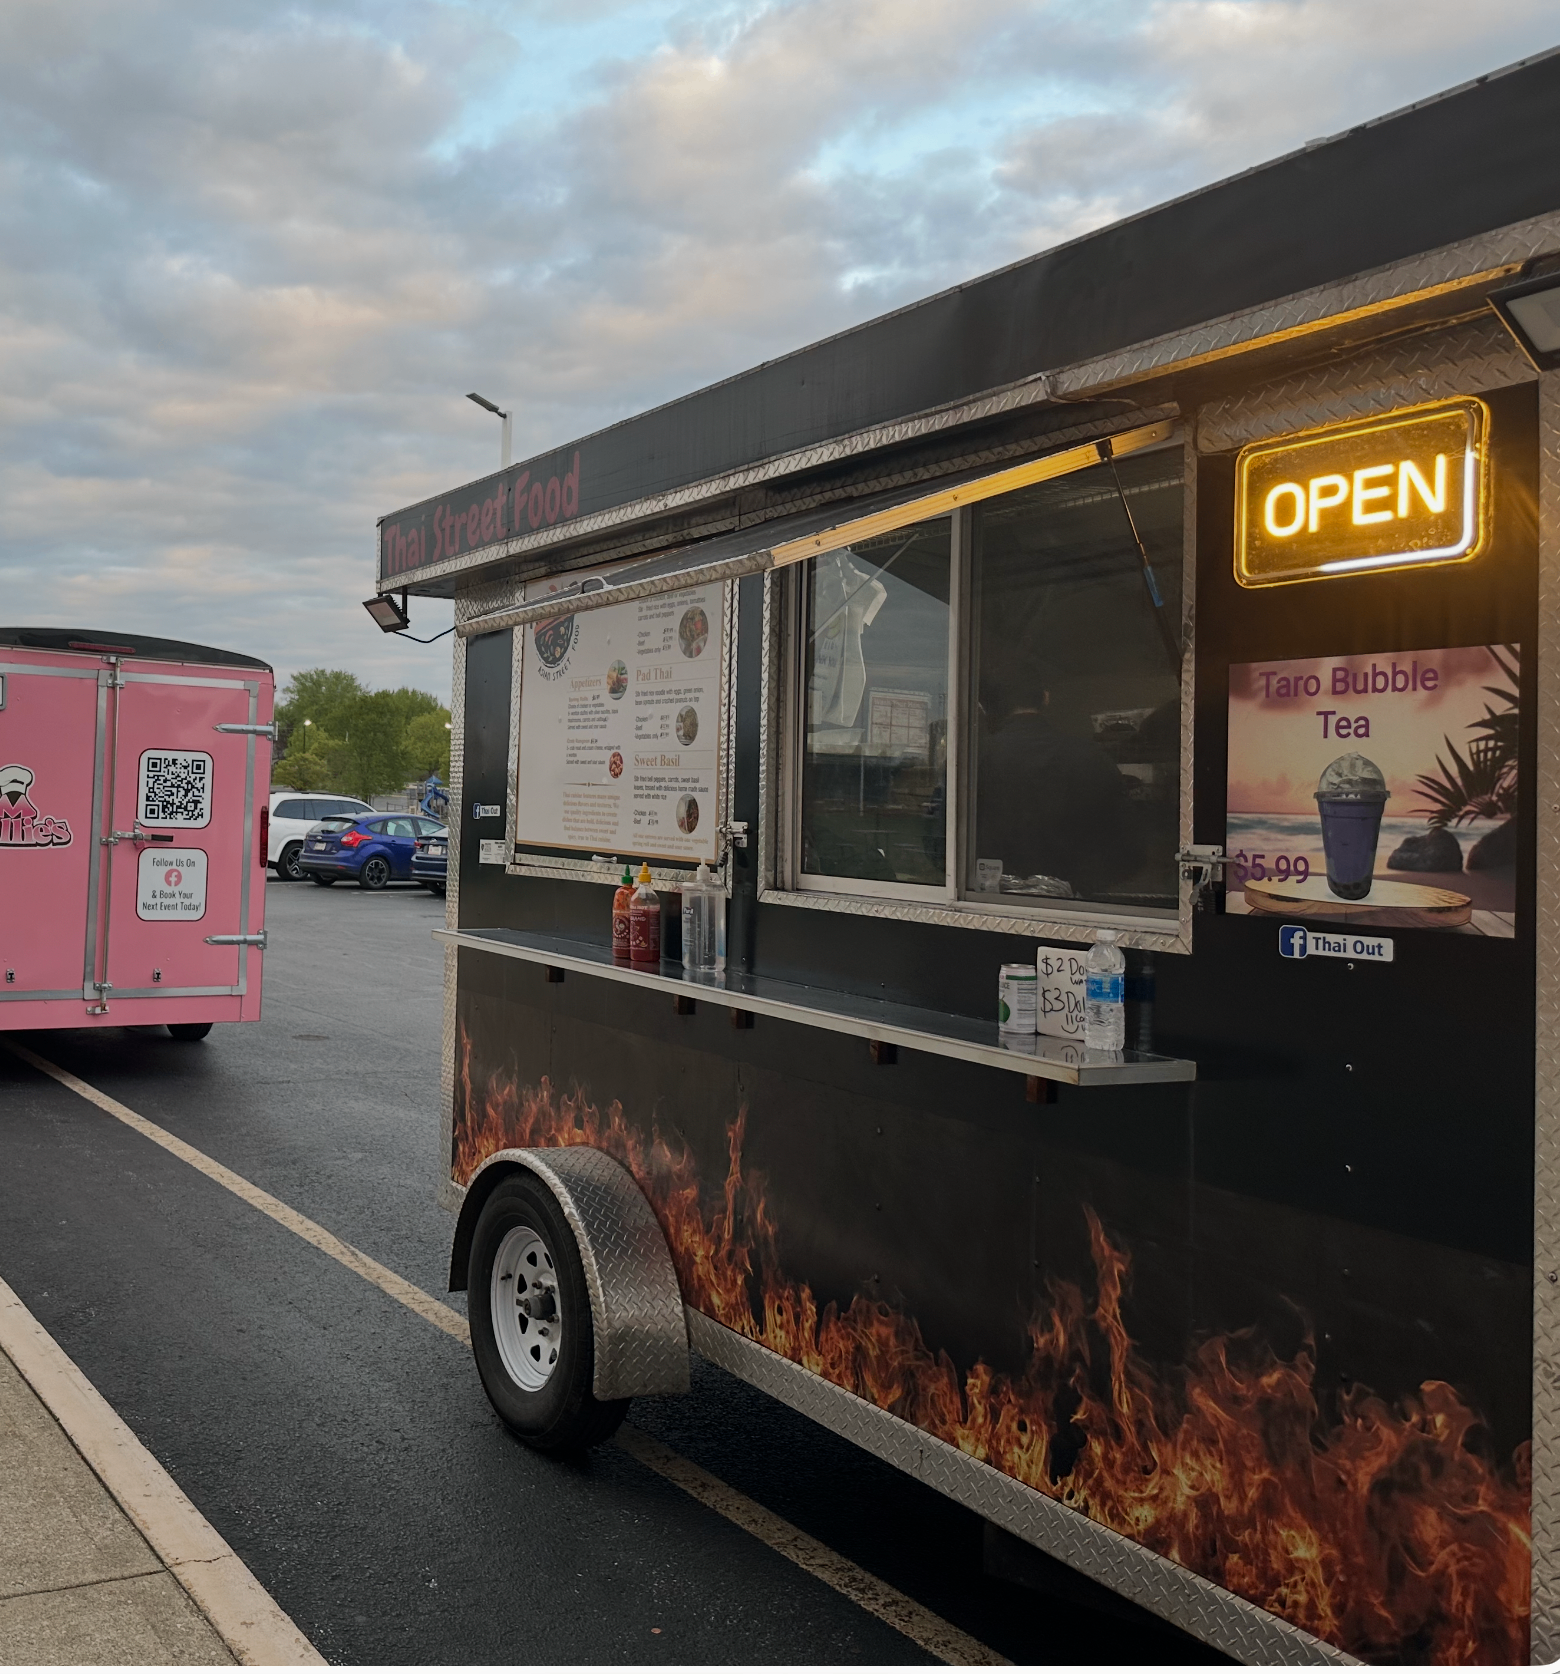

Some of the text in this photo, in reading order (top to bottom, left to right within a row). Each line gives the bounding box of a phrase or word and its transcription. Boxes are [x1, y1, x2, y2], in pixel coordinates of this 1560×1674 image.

[1265, 453, 1446, 537] OPEN
[384, 451, 580, 574] Thai Street Food
[553, 657, 571, 681] STREET
[572, 625, 580, 651] FOOD
[570, 677, 601, 691] Appetizers
[636, 667, 672, 681] Pad Thai
[1259, 661, 1438, 698] Taro Bubble
[1316, 710, 1370, 739] Tea
[634, 754, 680, 766] Sweet Basil
[0, 817, 72, 846] llie's
[153, 858, 195, 867] Follow Us On
[1233, 849, 1310, 884] $5.99
[143, 902, 201, 912] Next Event Today!
[152, 890, 193, 899] & Book Your
[1312, 936, 1347, 954] Thai
[1353, 940, 1384, 957] Out
[1041, 955, 1086, 979] $2 Do
[1041, 987, 1065, 1018] $3
[1065, 991, 1085, 1014] Dol
